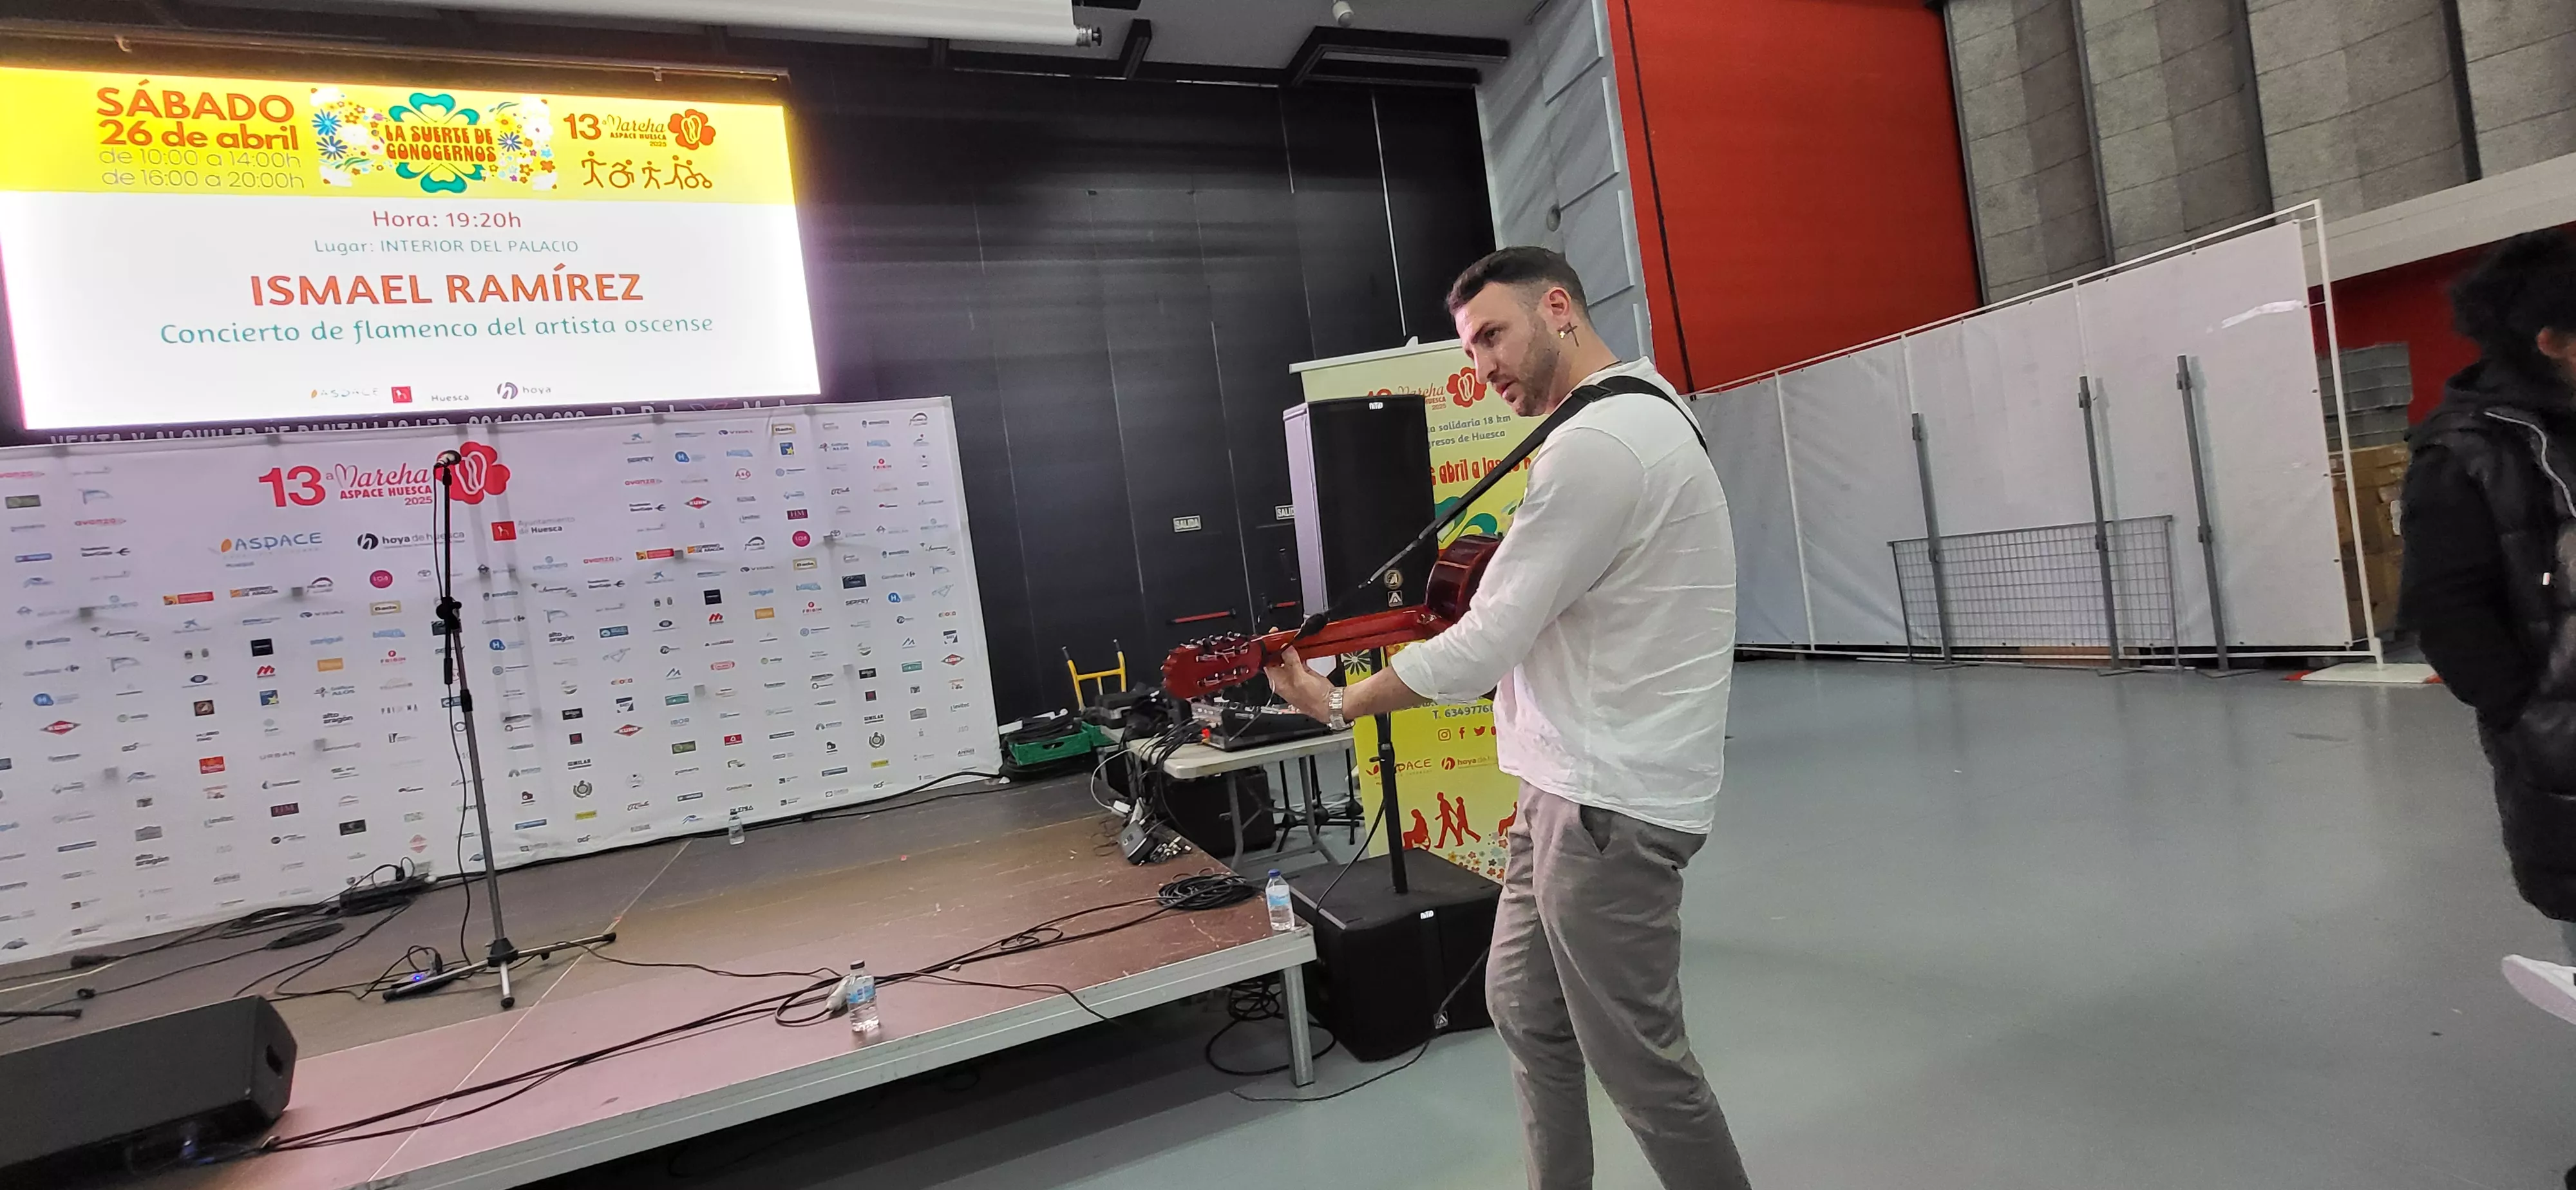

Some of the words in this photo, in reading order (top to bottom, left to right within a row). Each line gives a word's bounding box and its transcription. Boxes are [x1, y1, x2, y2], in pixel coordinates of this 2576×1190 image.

[96, 79, 295, 123] SÁBADO
[607, 114, 667, 133] Marcha
[99, 120, 153, 146] 26
[161, 122, 209, 148] de
[215, 124, 300, 151] abril
[384, 125, 406, 142] LA
[410, 126, 469, 144] SUERTE
[474, 128, 493, 145] DE
[99, 148, 133, 165] de
[140, 149, 199, 167] 10:00
[205, 153, 223, 167] a
[228, 150, 301, 169] 14:00h
[101, 168, 135, 187] de
[140, 169, 198, 187] 16:00
[205, 173, 222, 187] a
[228, 171, 305, 189] 20:00h
[373, 211, 439, 229] Hora:
[446, 211, 522, 229] 19:20h
[314, 240, 374, 256] Lugar:
[381, 240, 464, 253] INTERIOR
[471, 240, 502, 252] DEL
[508, 240, 579, 252] PALACIO
[251, 274, 433, 306] ISMAEL
[446, 262, 643, 303] RAMÍREZ
[160, 322, 300, 345] Concierto
[311, 320, 343, 341] de
[354, 320, 478, 345] flamenco
[488, 317, 526, 336] del
[536, 317, 616, 335] artista
[625, 316, 714, 333] oscense
[431, 393, 470, 402] Huesca
[1439, 419, 1481, 432] solidaria
[1483, 417, 1495, 427] 18
[1496, 415, 1511, 424] km
[1457, 432, 1470, 444] de
[1472, 430, 1506, 442] Huesca
[334, 463, 431, 487] Marcha
[1439, 458, 1469, 484] abril
[1472, 460, 1480, 478] a
[339, 487, 384, 500] ASPACE
[388, 485, 433, 498] HUESCA
[404, 496, 433, 506] 2025
[1277, 505, 1294, 518] SALID
[531, 525, 564, 534] Huesca
[1174, 518, 1199, 530] SALIDA
[382, 534, 411, 545] hoya
[1457, 757, 1477, 766] hoya
